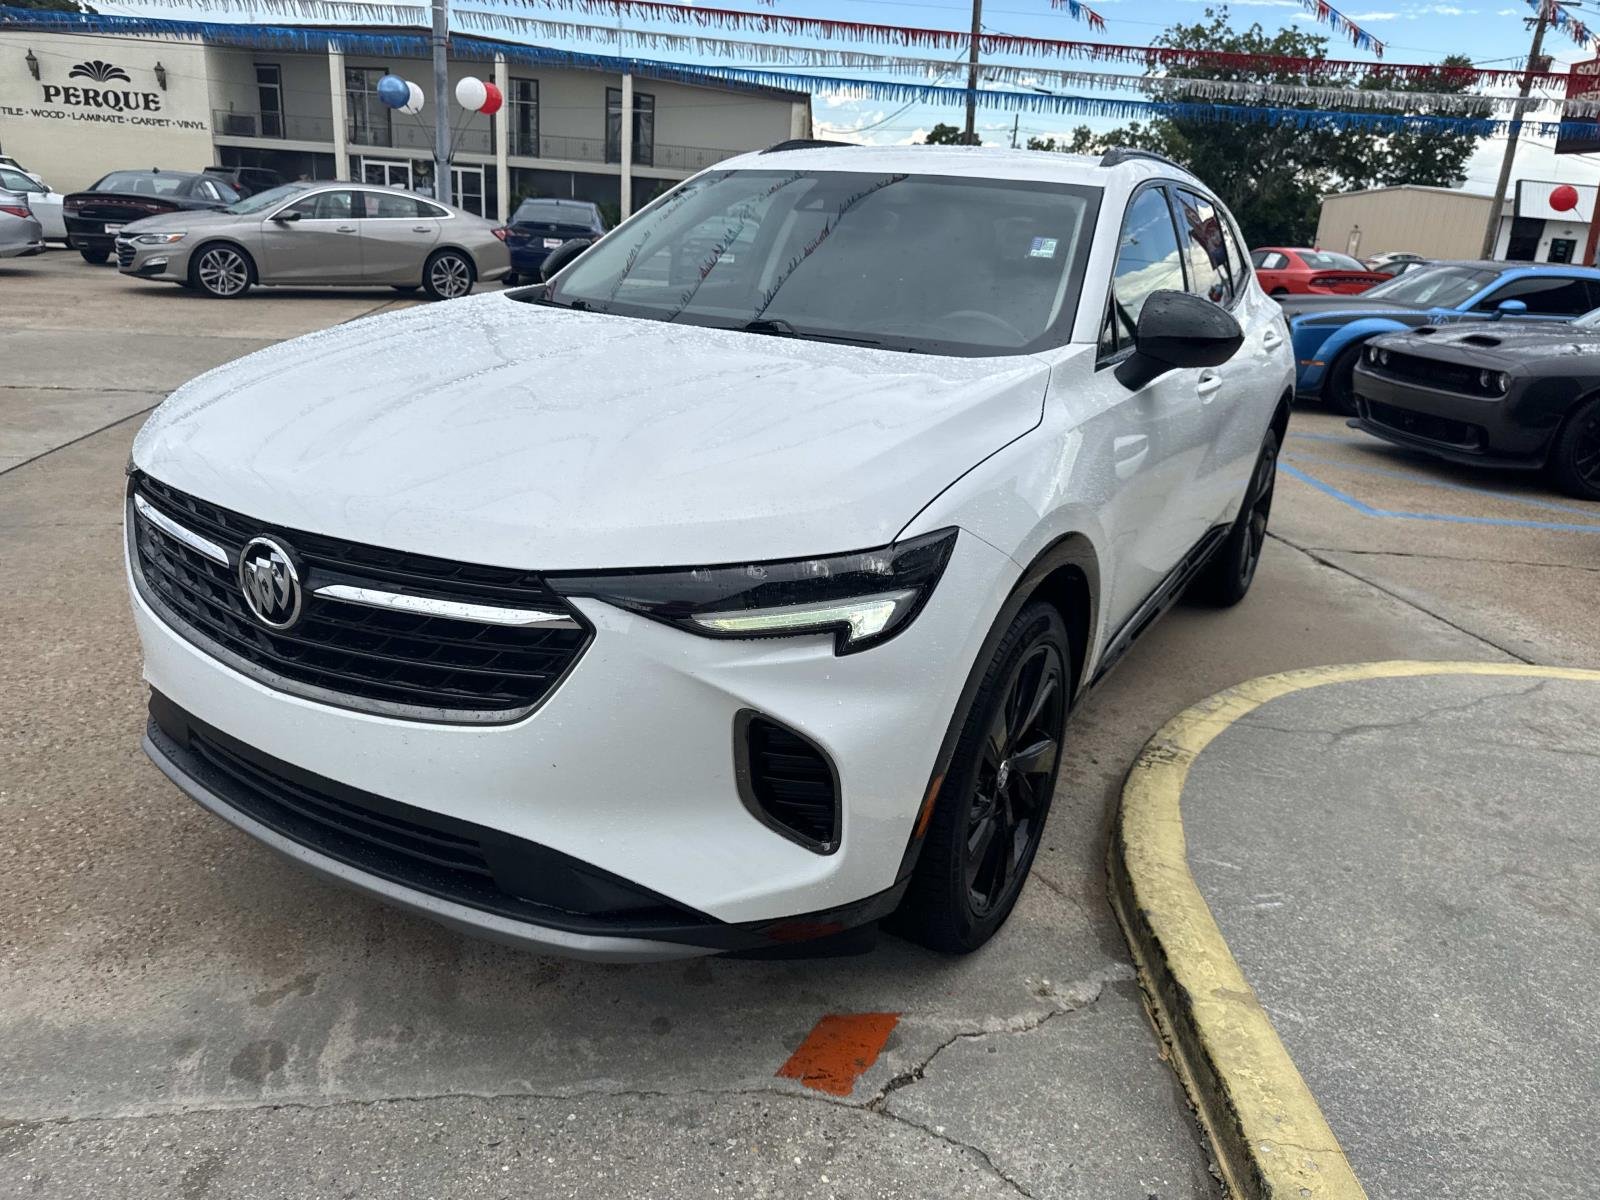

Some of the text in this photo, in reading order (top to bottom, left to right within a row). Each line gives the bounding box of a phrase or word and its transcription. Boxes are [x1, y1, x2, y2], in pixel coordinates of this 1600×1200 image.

[42, 84, 161, 112] PERQUE
[0, 106, 208, 131] TILE WOOD LAMINATE CARPET VINYL
